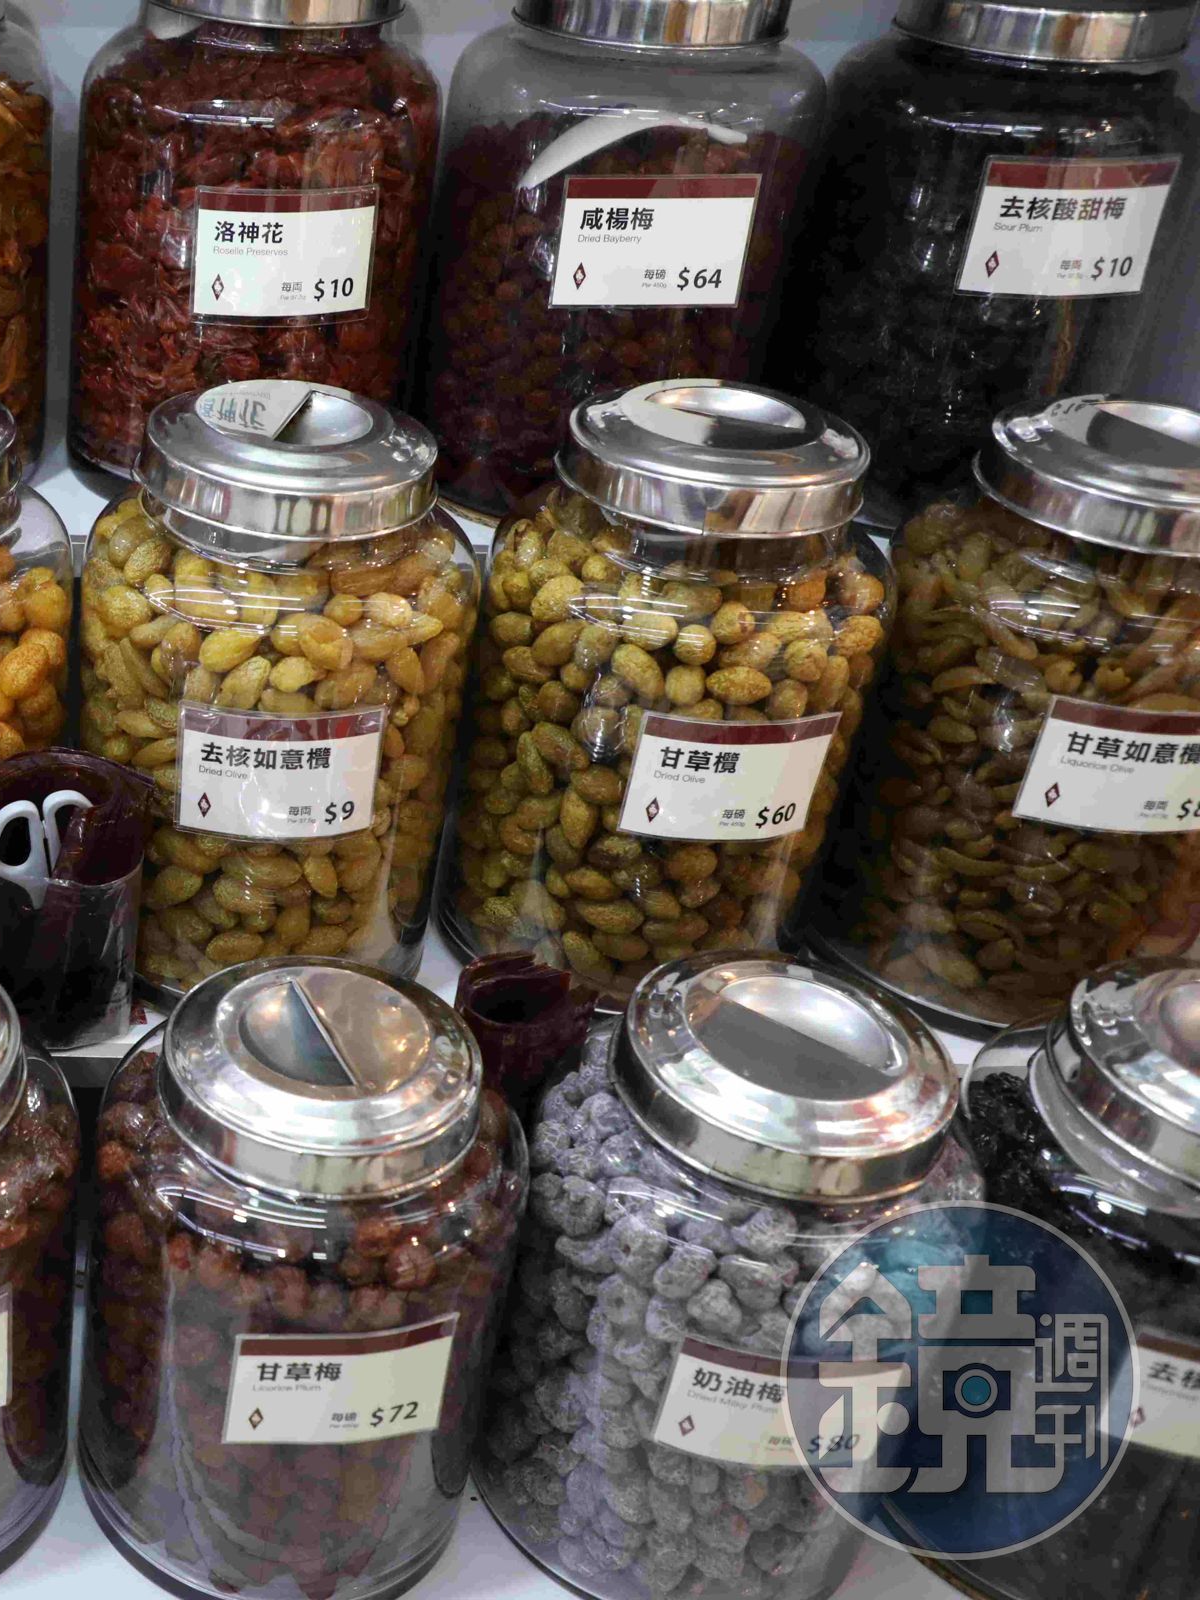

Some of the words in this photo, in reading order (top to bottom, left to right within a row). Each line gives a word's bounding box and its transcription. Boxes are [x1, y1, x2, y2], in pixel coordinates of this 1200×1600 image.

[580, 207, 655, 230] 咸楊梅
[999, 195, 1127, 221] 去核酸甜梅
[214, 221, 283, 244] 洛神花
[993, 222, 1016, 231] Sour
[1017, 223, 1043, 232] Plum
[577, 234, 601, 243] Dried
[603, 234, 642, 245] Bayberry
[246, 247, 288, 256] Preserves
[644, 269, 667, 280] 每磅
[677, 267, 722, 291] $64
[1091, 256, 1133, 281] $10
[314, 277, 354, 302] $10
[201, 742, 331, 770] 去核如意欖
[660, 746, 740, 774] 甘草欖
[199, 765, 222, 777] Dried
[225, 769, 248, 780] Olive
[653, 770, 680, 782] Dried
[682, 774, 706, 784] Olive
[325, 801, 355, 824] $9
[721, 809, 746, 820] 每磅
[756, 802, 796, 829] $60
[257, 1362, 343, 1382] 甘草梅
[692, 1368, 787, 1404] 奶油梅
[370, 1401, 419, 1428] $72
